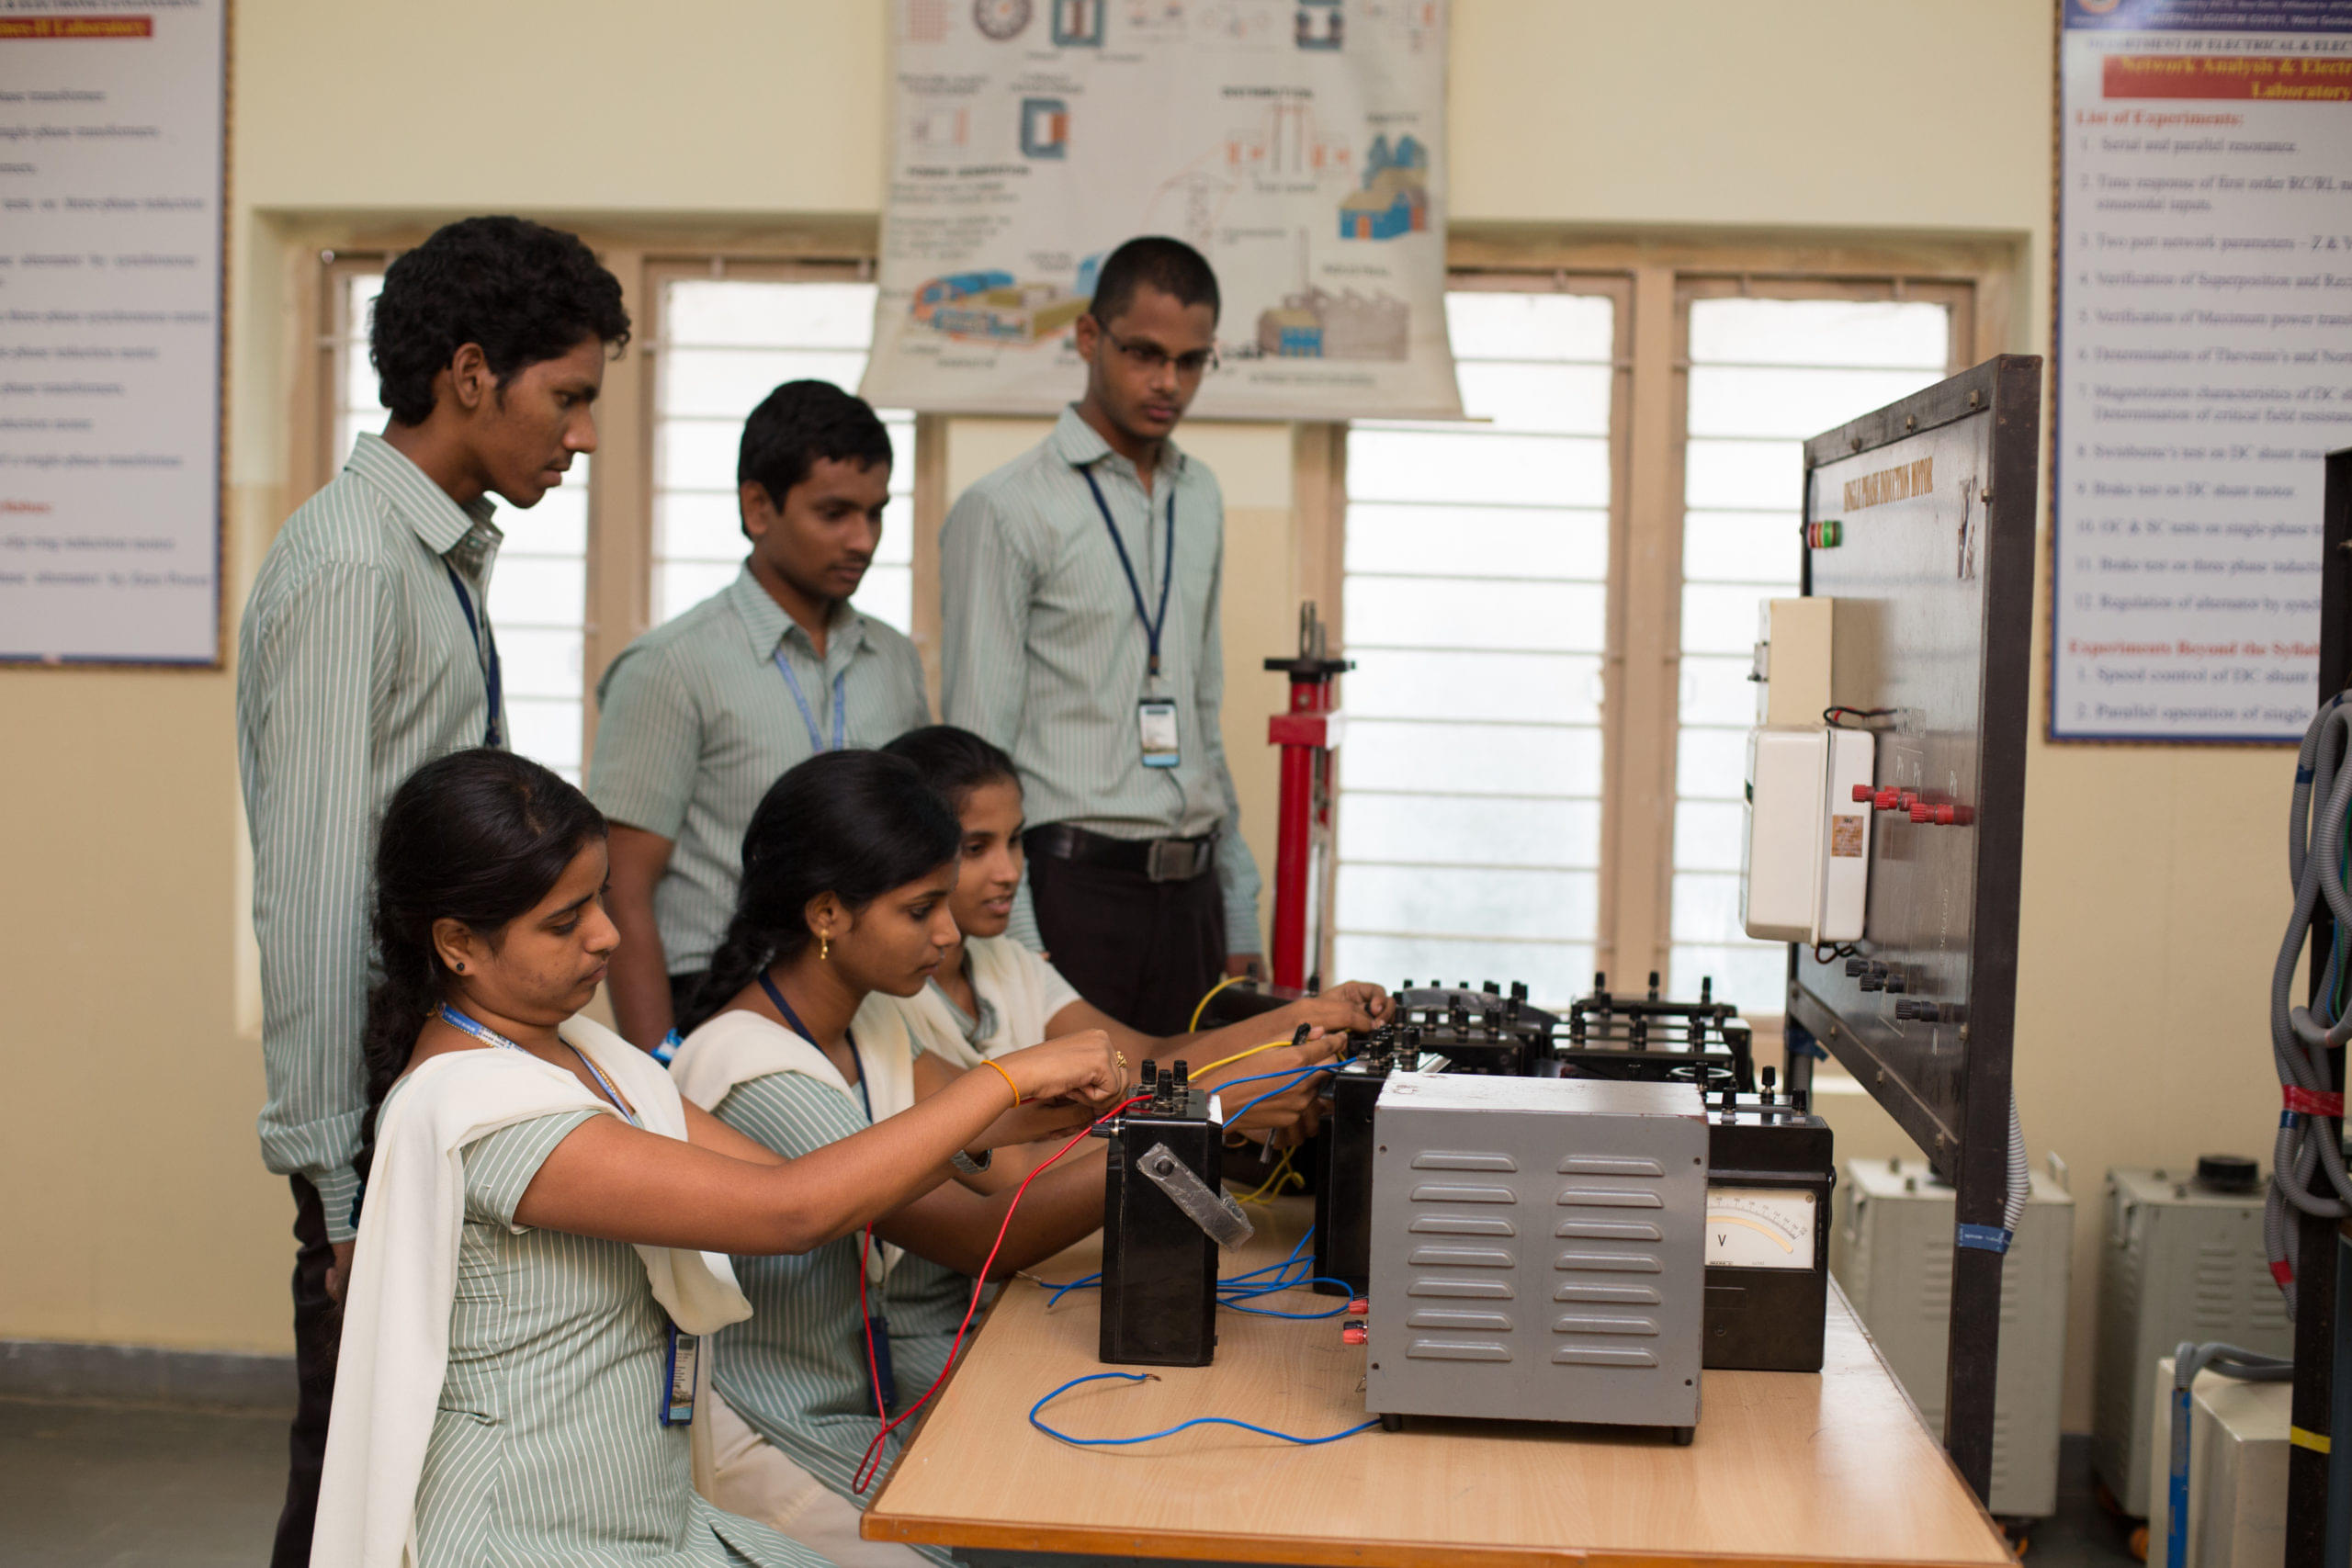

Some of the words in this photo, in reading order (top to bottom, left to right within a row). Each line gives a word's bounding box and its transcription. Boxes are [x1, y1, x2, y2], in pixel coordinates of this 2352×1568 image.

[2120, 57, 2196, 73] Network
[2202, 57, 2275, 79] Analysis
[2278, 59, 2297, 75] &
[2251, 81, 2352, 101] Laboratory
[2076, 110, 2108, 125] List
[2113, 110, 2130, 125] of
[2133, 110, 2244, 129] Experiments:
[2180, 272, 2197, 287] of
[2179, 310, 2197, 323] of
[2198, 347, 2212, 362] of
[2196, 408, 2211, 423] of
[1911, 455, 1933, 498] MOTOR
[2178, 595, 2194, 609] of
[2067, 637, 2172, 658] Experiments
[2176, 639, 2237, 660] Beyond
[2242, 639, 2267, 656] the
[2096, 667, 2146, 685] Speed
[2211, 668, 2229, 683] of
[2242, 704, 2259, 720] of
[1717, 1234, 1727, 1247] V
